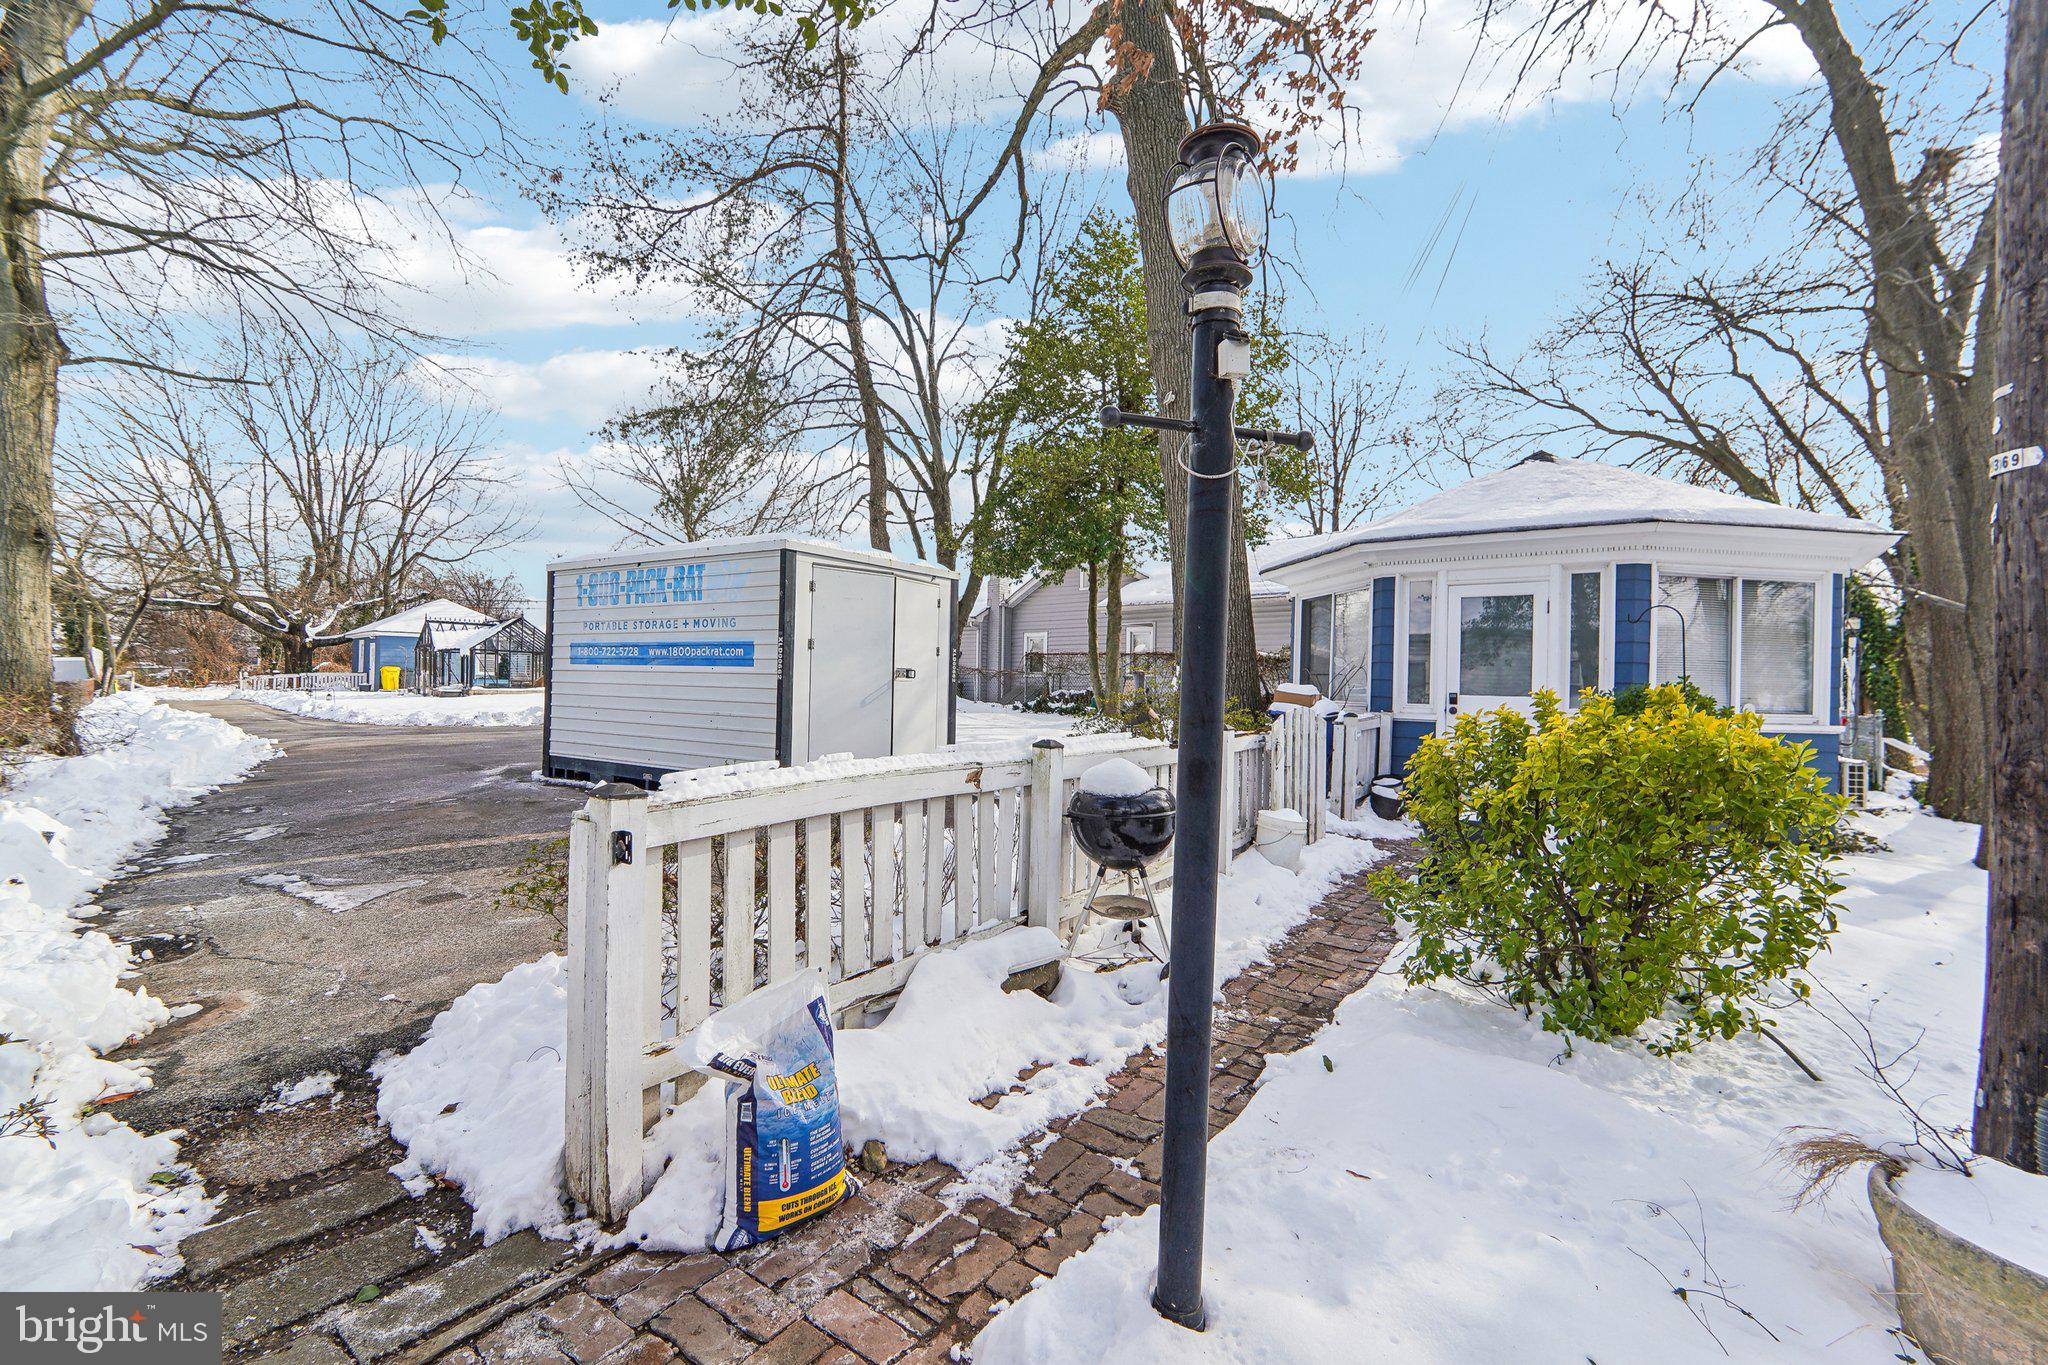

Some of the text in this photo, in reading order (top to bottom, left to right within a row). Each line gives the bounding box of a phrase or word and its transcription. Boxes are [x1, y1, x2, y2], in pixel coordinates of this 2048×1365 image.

[1993, 453, 2019, 471] 369
[576, 563, 706, 607] 1-800-PACK-RAT
[583, 621, 628, 631] PORTABLE
[632, 619, 678, 630] STORAGE
[693, 617, 737, 629] MOVING
[577, 646, 744, 658] 1-800-722-5728 www.1800packrat.com
[743, 1147, 752, 1212] ULTIMATE BLEND
[778, 1208, 803, 1223] WORKS
[803, 1204, 813, 1214] ON
[781, 1200, 799, 1212] CUTS
